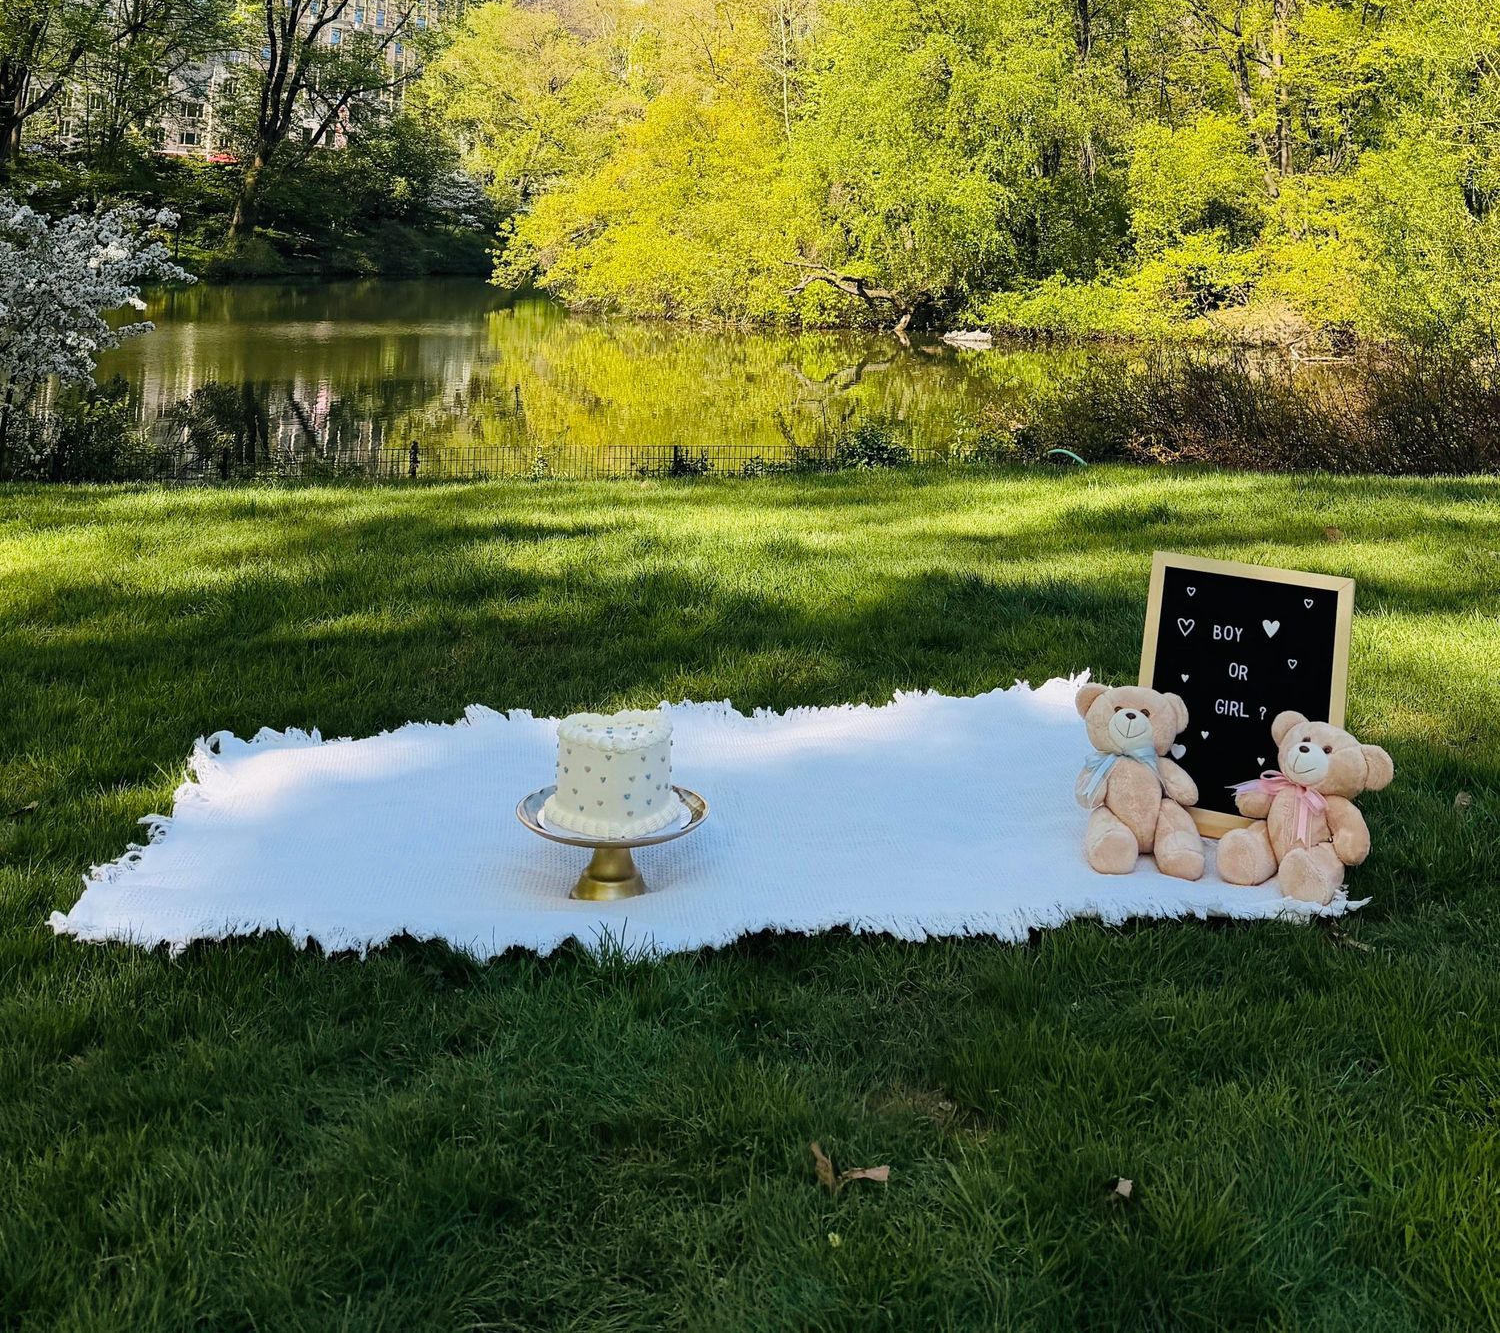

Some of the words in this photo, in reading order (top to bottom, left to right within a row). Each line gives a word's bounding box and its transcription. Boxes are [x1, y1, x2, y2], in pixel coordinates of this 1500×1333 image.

[1213, 624, 1243, 642] BOY
[1228, 663, 1248, 681] OR
[1215, 699, 1250, 718] GIRL
[1259, 706, 1267, 720] ?
